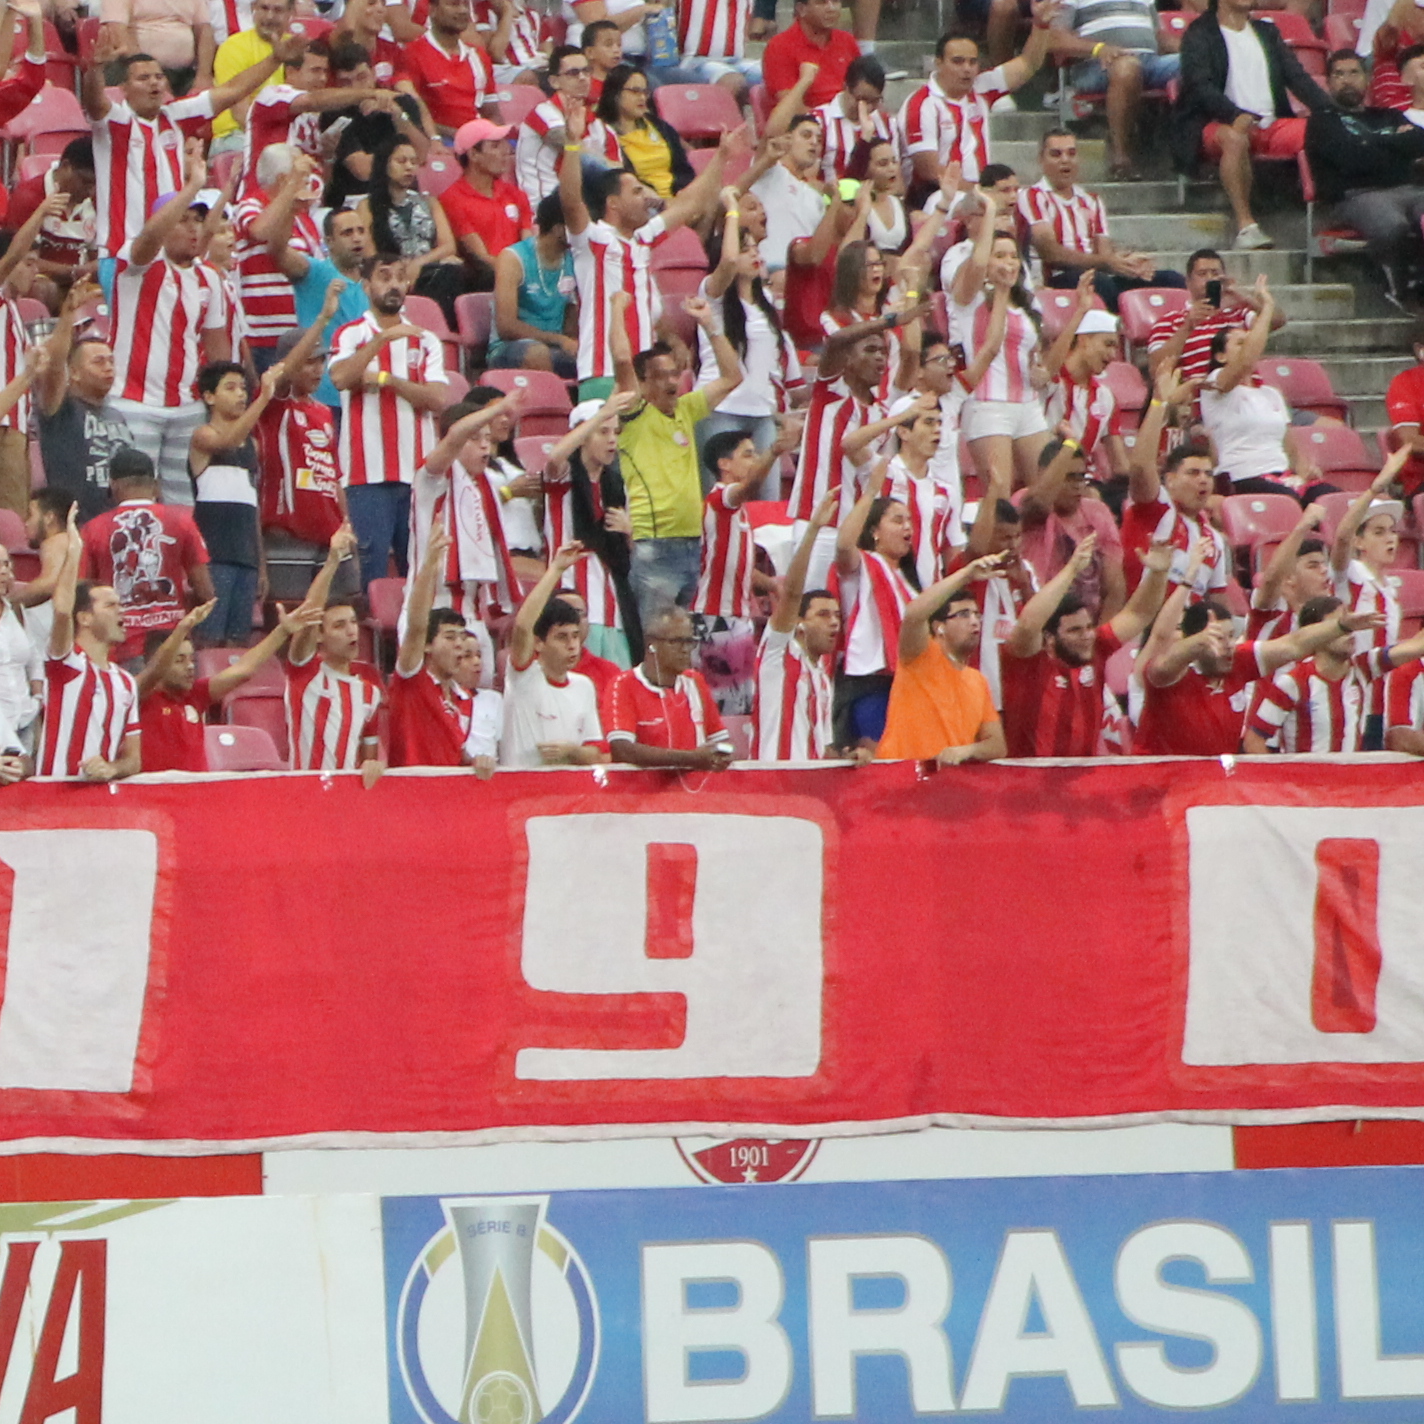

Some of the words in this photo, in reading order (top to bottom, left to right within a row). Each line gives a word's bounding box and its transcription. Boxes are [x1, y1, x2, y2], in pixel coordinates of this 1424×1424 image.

[728, 1145, 770, 1169] 1901
[467, 1219, 512, 1237] SÉRIE
[640, 1218, 1424, 1424] BRASIL
